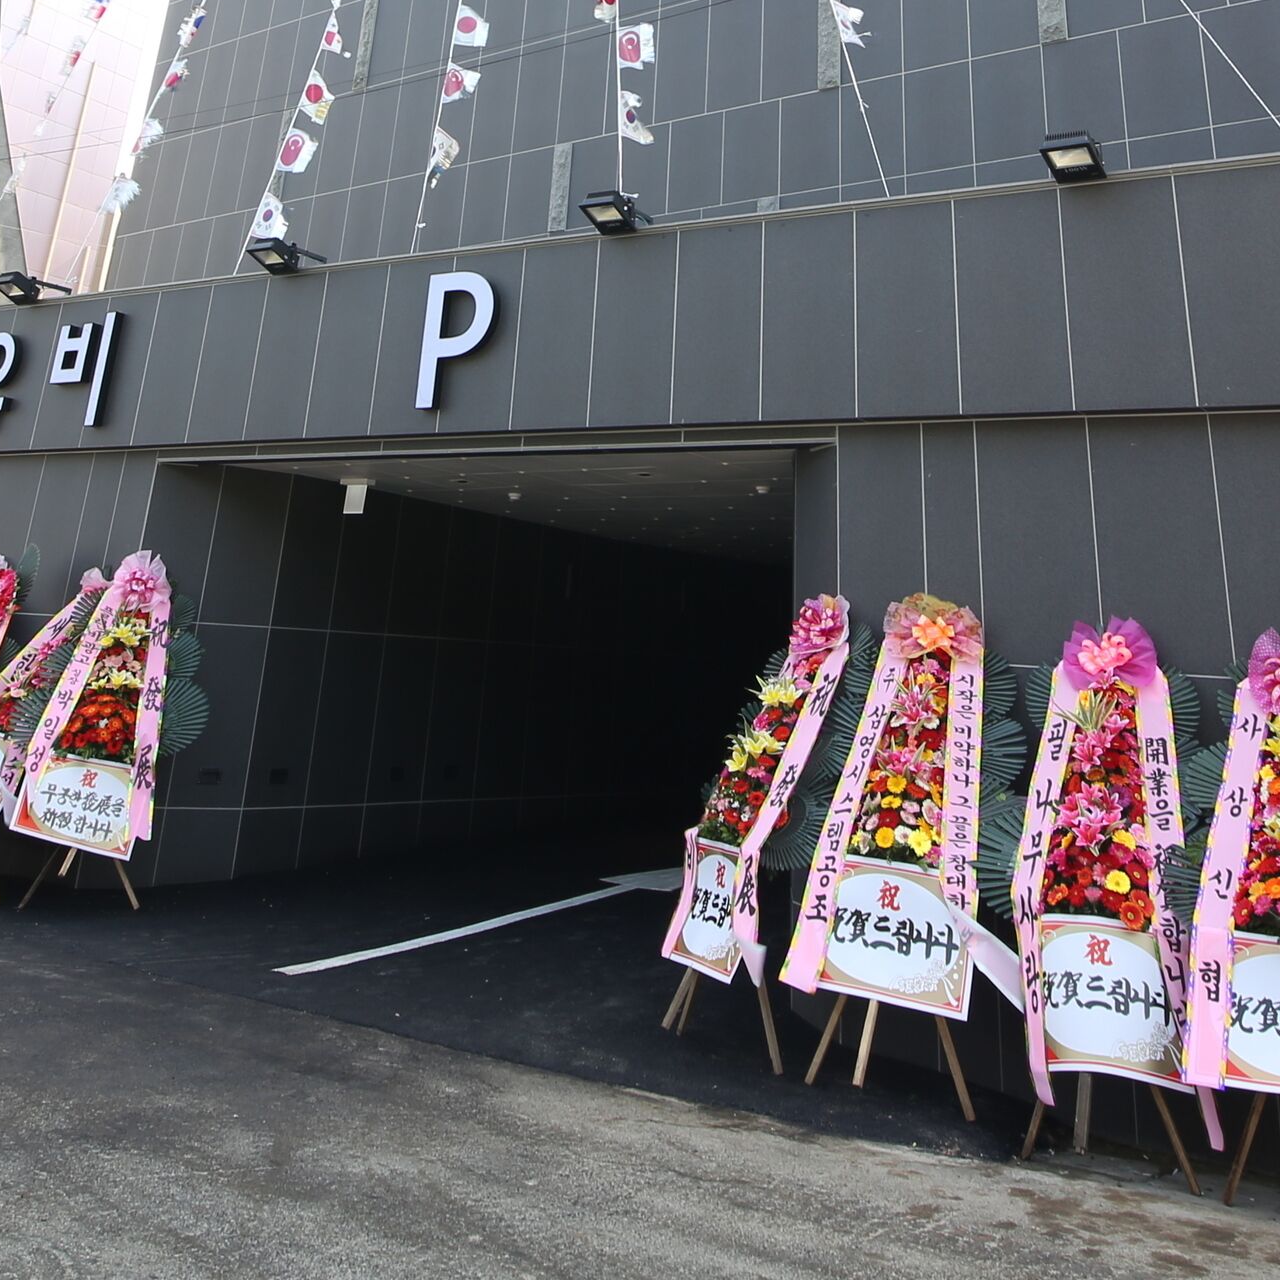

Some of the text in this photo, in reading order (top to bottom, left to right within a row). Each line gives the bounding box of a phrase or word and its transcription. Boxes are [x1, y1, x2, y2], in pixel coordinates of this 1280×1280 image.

[415, 271, 497, 410] P
[80, 769, 98, 788] 祝
[876, 879, 902, 911] 祝
[1083, 932, 1114, 966] 祝
